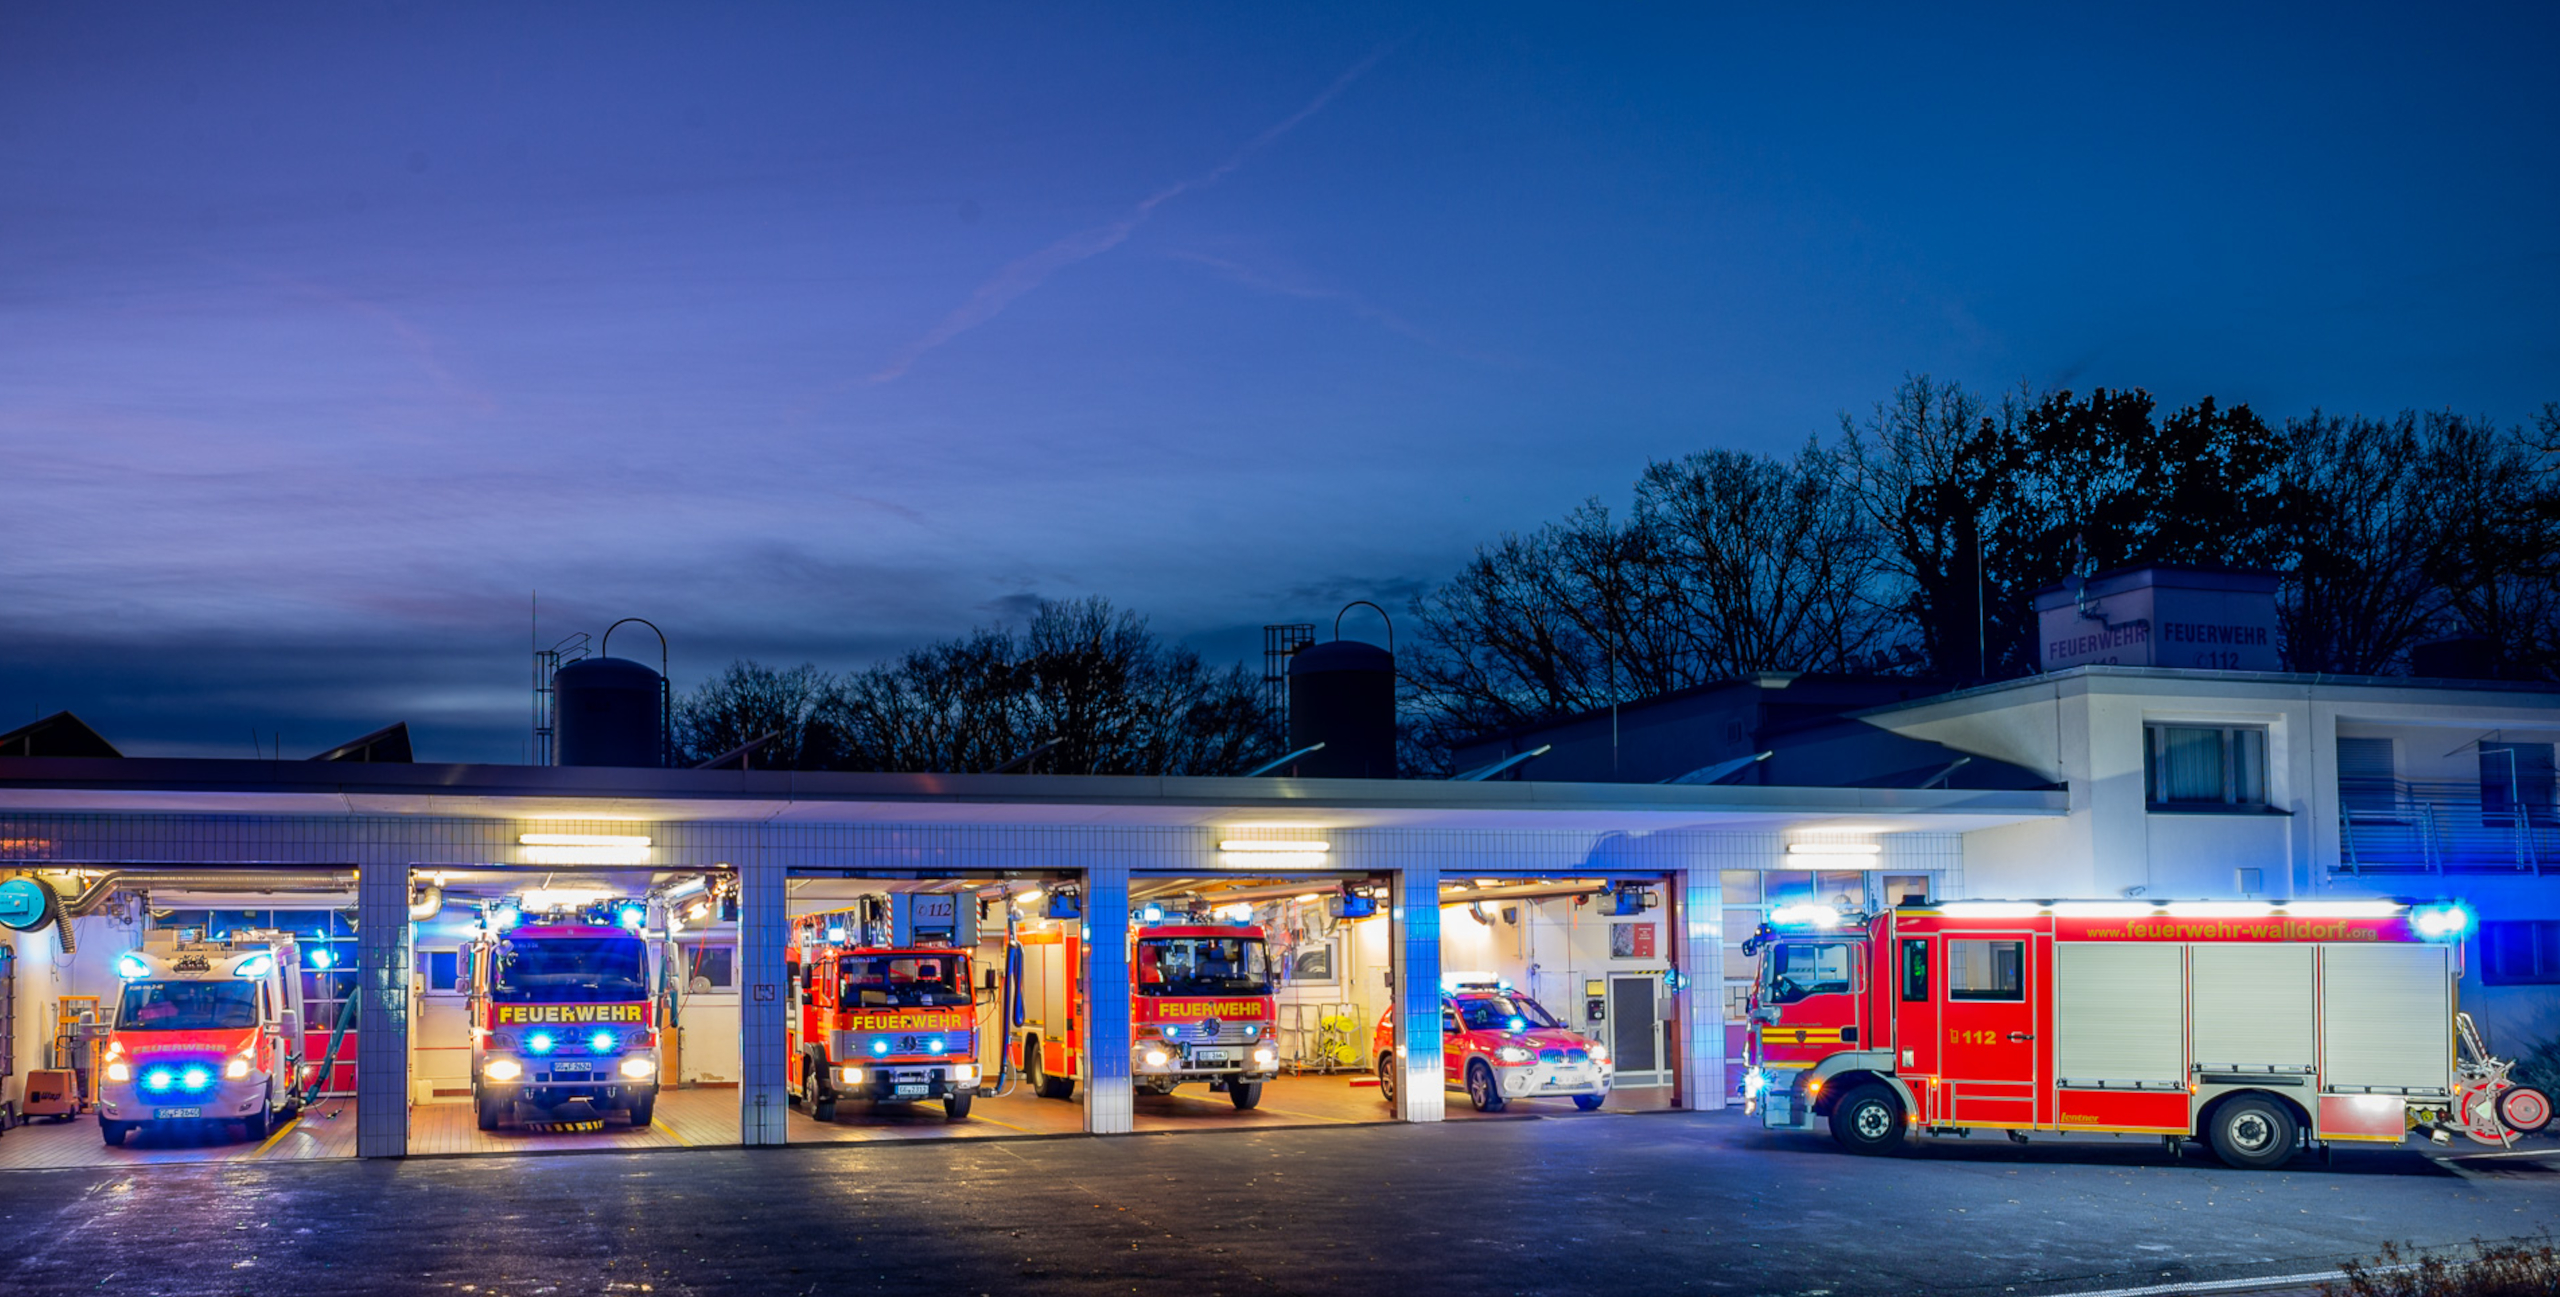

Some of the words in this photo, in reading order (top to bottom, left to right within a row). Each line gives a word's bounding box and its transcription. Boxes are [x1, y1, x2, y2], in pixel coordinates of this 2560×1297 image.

[2165, 623, 2267, 645] FEUERWEHR
[2049, 625, 2145, 660] FEUERWEHR
[2209, 651, 2239, 669] 112
[929, 903, 952, 916] 112
[2087, 920, 2377, 942] www.feuerwehr-walldorf.org
[500, 1005, 642, 1023] FEUERWEHR
[1159, 1002, 1261, 1017] FEUERWEHR
[853, 1014, 962, 1029] FEUERWEHR
[1962, 1030, 1997, 1045] 112
[131, 1043, 227, 1055] FEUERWEHR
